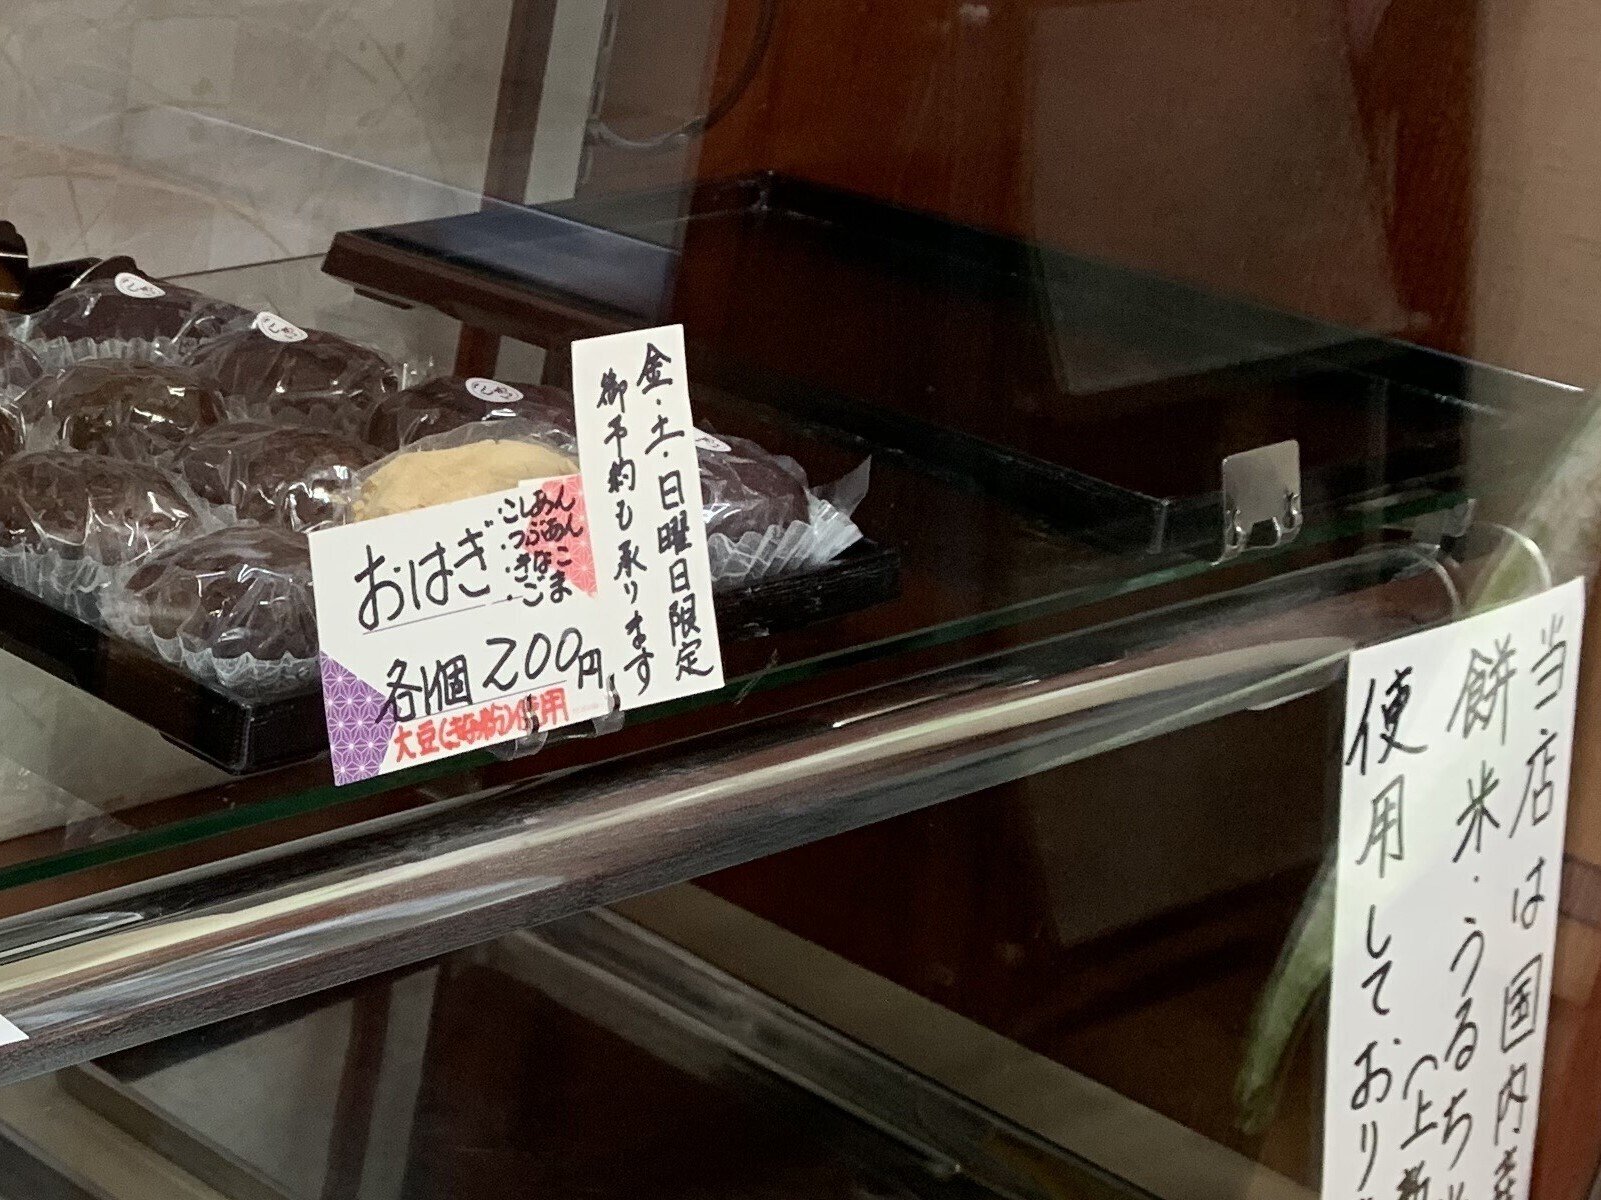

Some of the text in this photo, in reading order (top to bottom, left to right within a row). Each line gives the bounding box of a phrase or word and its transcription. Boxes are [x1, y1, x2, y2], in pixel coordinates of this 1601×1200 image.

[355, 519, 494, 630] おはぎ
[596, 366, 655, 697] 御予約も承ります
[637, 342, 715, 682] 金・土・日曜日限定
